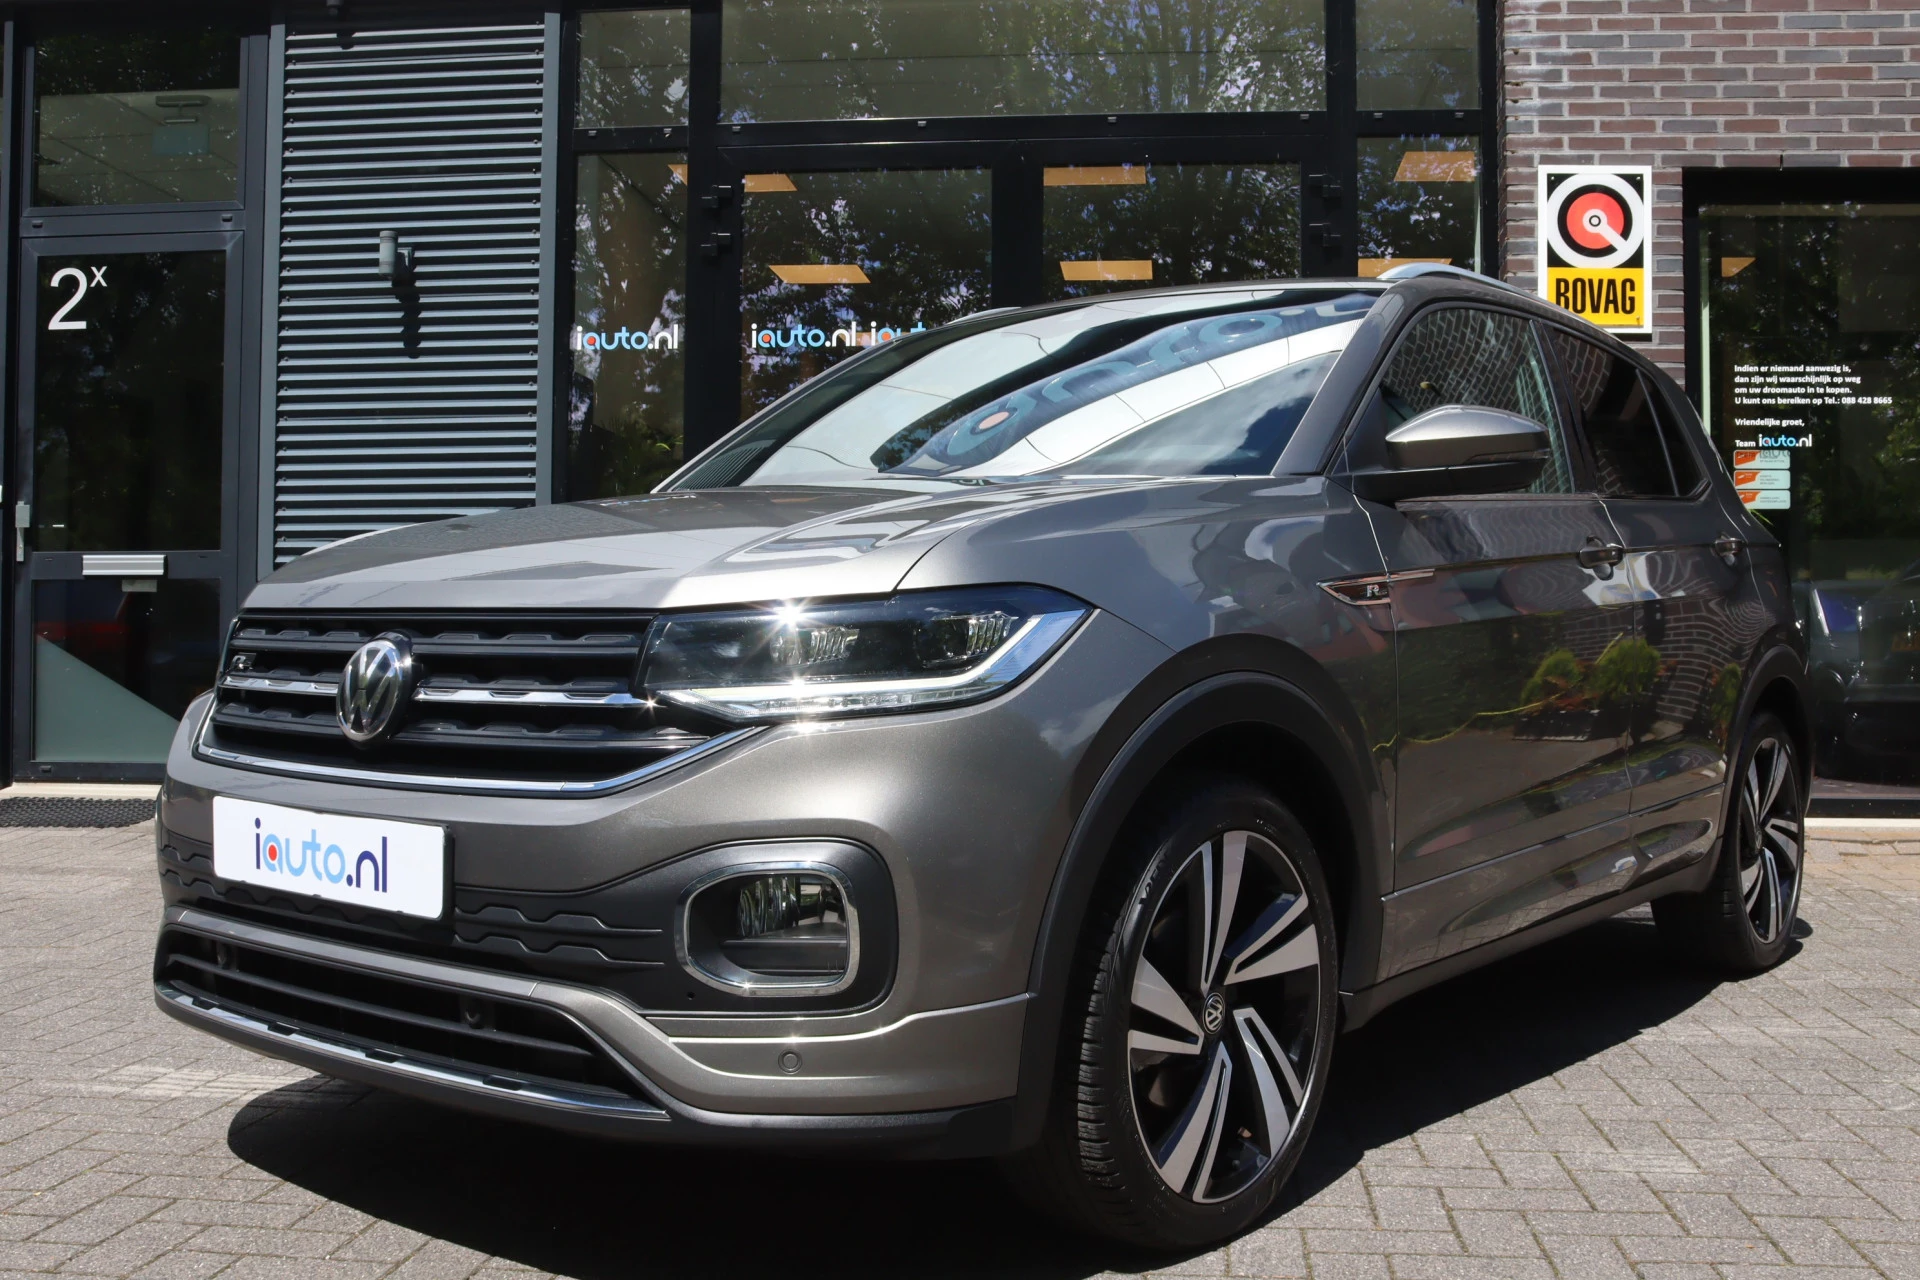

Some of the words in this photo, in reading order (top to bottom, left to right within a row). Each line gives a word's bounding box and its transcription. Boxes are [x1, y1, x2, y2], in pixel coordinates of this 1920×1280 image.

[1555, 277, 1636, 314] BOVAG
[576, 325, 679, 350] iauto.nl
[751, 322, 856, 348] iauto.nl
[1734, 364, 1759, 372] Indien
[1770, 364, 1804, 372] niemand
[1805, 364, 1841, 373] aanwezig
[1842, 364, 1852, 373] is,
[1734, 375, 1750, 383] dan
[1751, 375, 1765, 384] zijn
[1766, 375, 1778, 384] wij
[1779, 375, 1832, 384] waarschijnlijk
[1763, 386, 1806, 394] droomauto
[1807, 386, 1815, 394] in
[1816, 386, 1825, 394] te
[1826, 386, 1853, 395] kopen.
[1743, 396, 1761, 404] kunt
[1777, 396, 1811, 404] bereiken
[1824, 396, 1841, 404] Tel.:
[1734, 418, 1781, 427] Vriendelijke
[1781, 418, 1805, 427] groet,
[1734, 439, 1756, 447] Team
[1758, 433, 1813, 447] iauto.nl
[254, 817, 388, 893] iauto.nl
